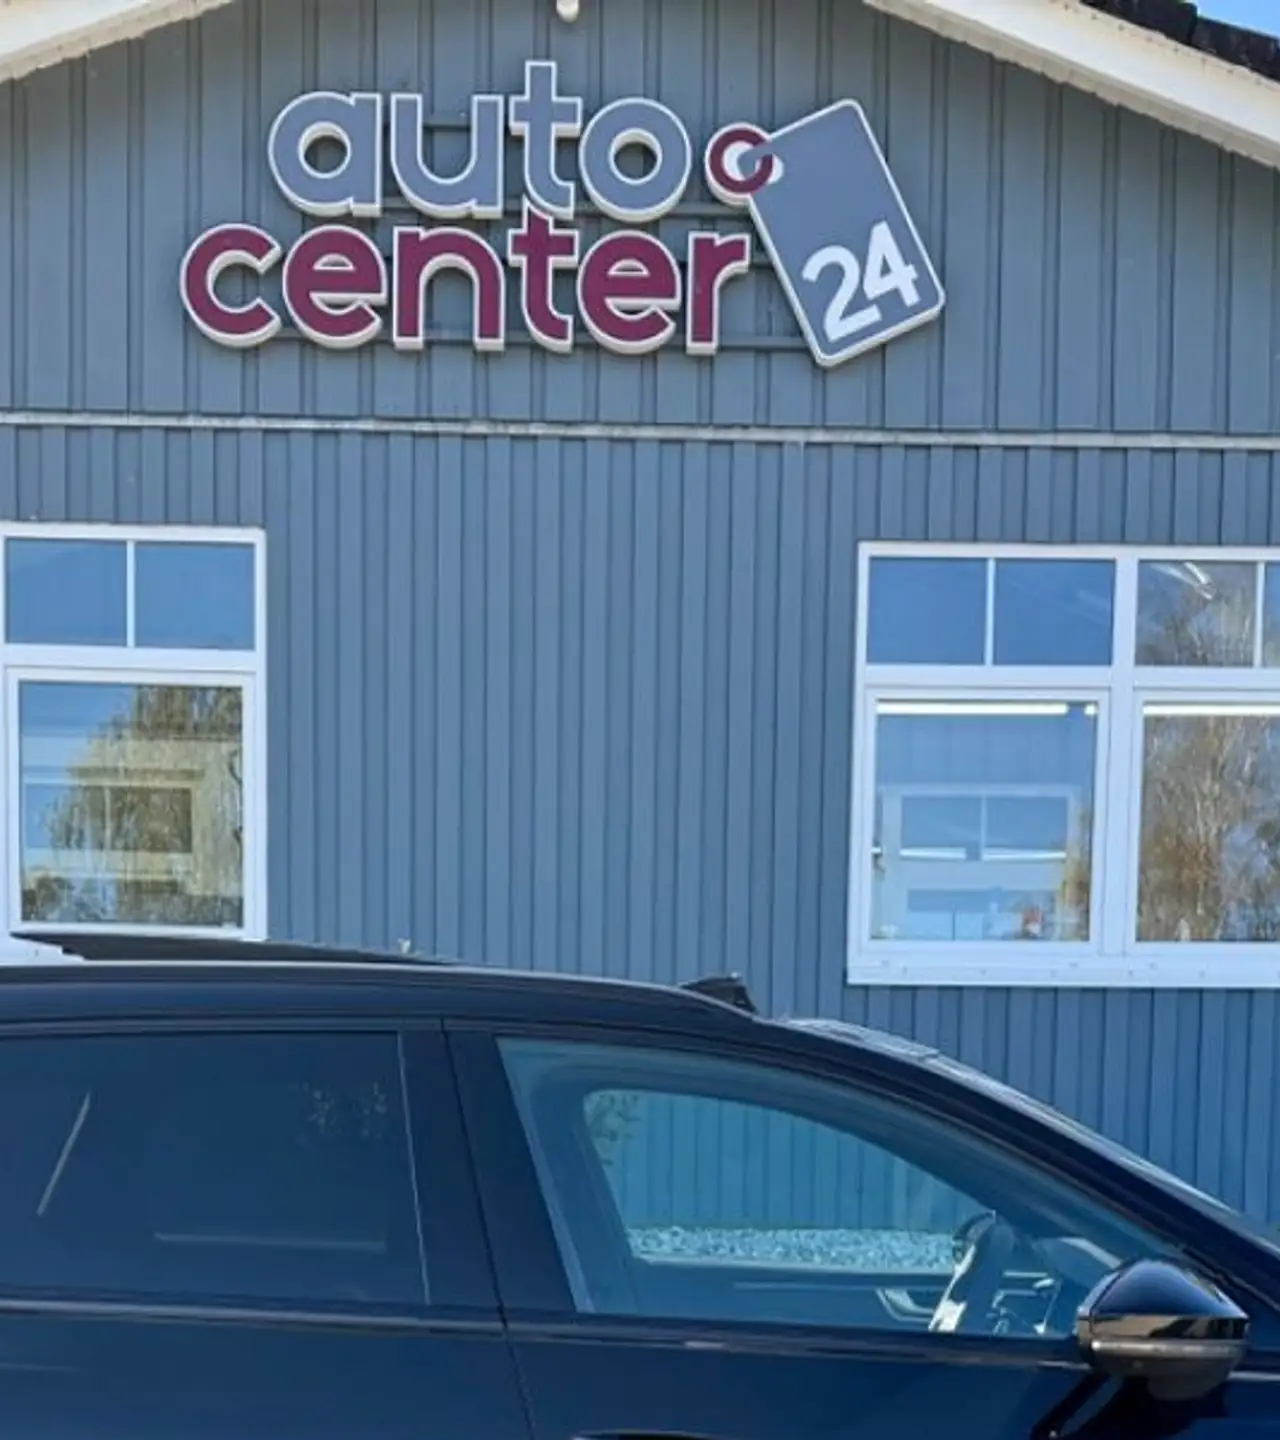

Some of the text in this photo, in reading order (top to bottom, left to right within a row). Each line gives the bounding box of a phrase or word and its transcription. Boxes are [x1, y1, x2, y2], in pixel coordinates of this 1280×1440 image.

[268, 61, 692, 222] auto
[180, 196, 750, 354] center
[802, 220, 921, 343] 24
